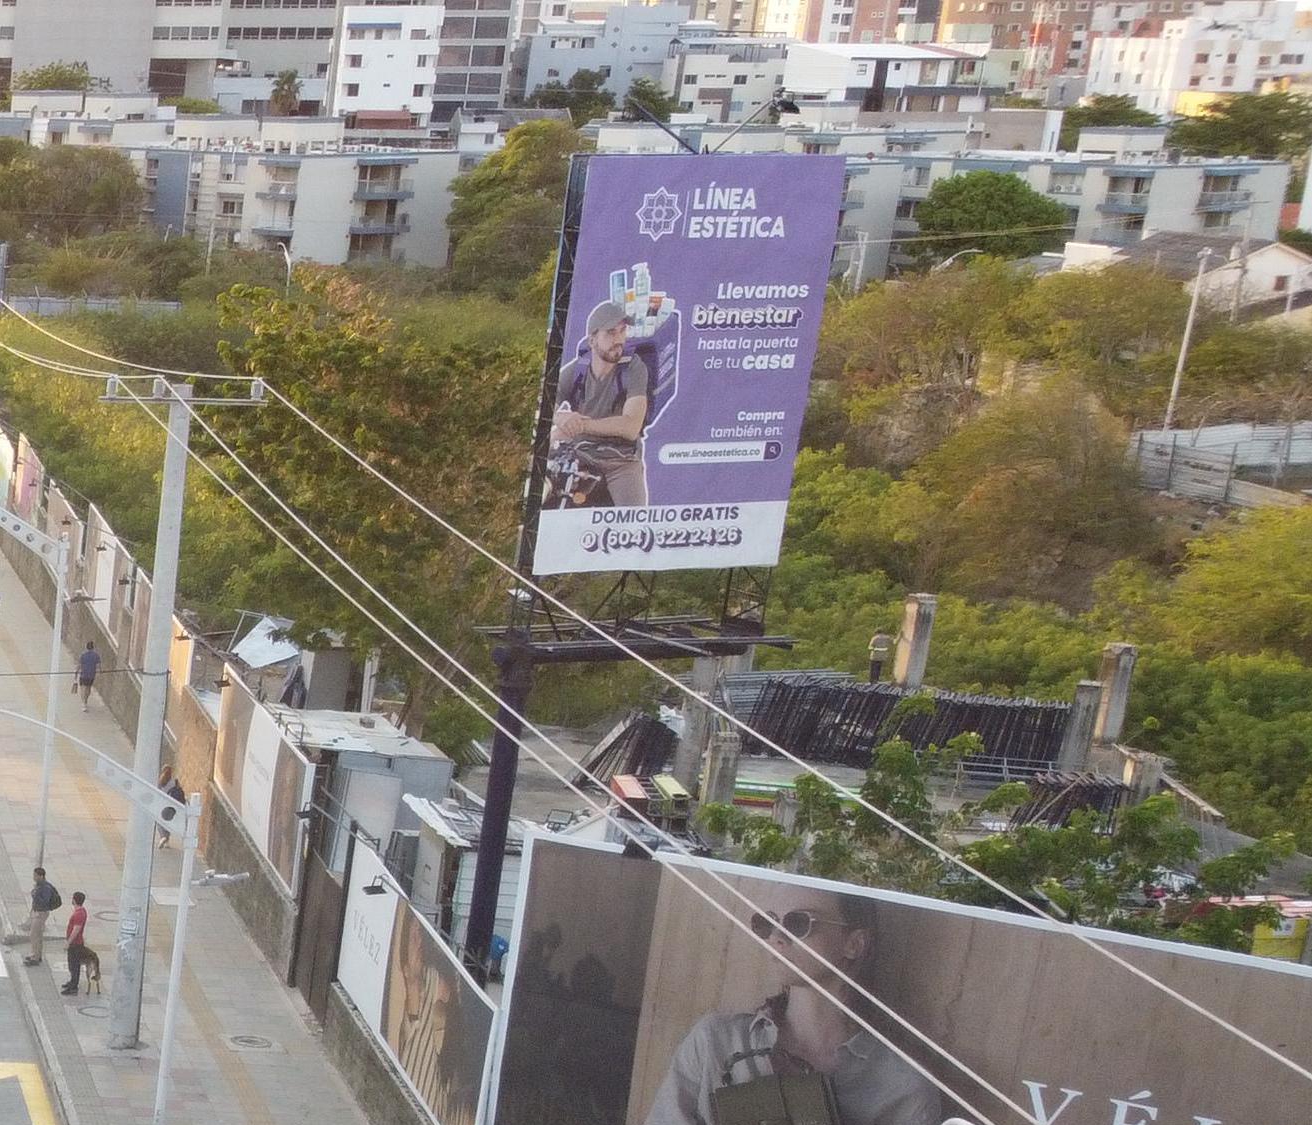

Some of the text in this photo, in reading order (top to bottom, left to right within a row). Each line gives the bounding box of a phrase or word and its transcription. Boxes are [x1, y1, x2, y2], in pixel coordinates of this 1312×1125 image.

[692, 181, 757, 210] LÍNEA
[688, 211, 785, 239] ESTÉTICA
[716, 282, 810, 300] Llevamos
[692, 303, 800, 327] bienestar
[697, 336, 799, 352] hasta la puerta
[704, 353, 796, 370] de tu casa
[737, 410, 785, 424] Compra
[710, 425, 783, 438] también en:
[591, 506, 740, 524] DOMICILIO GRATIS
[600, 526, 653, 552] (604)
